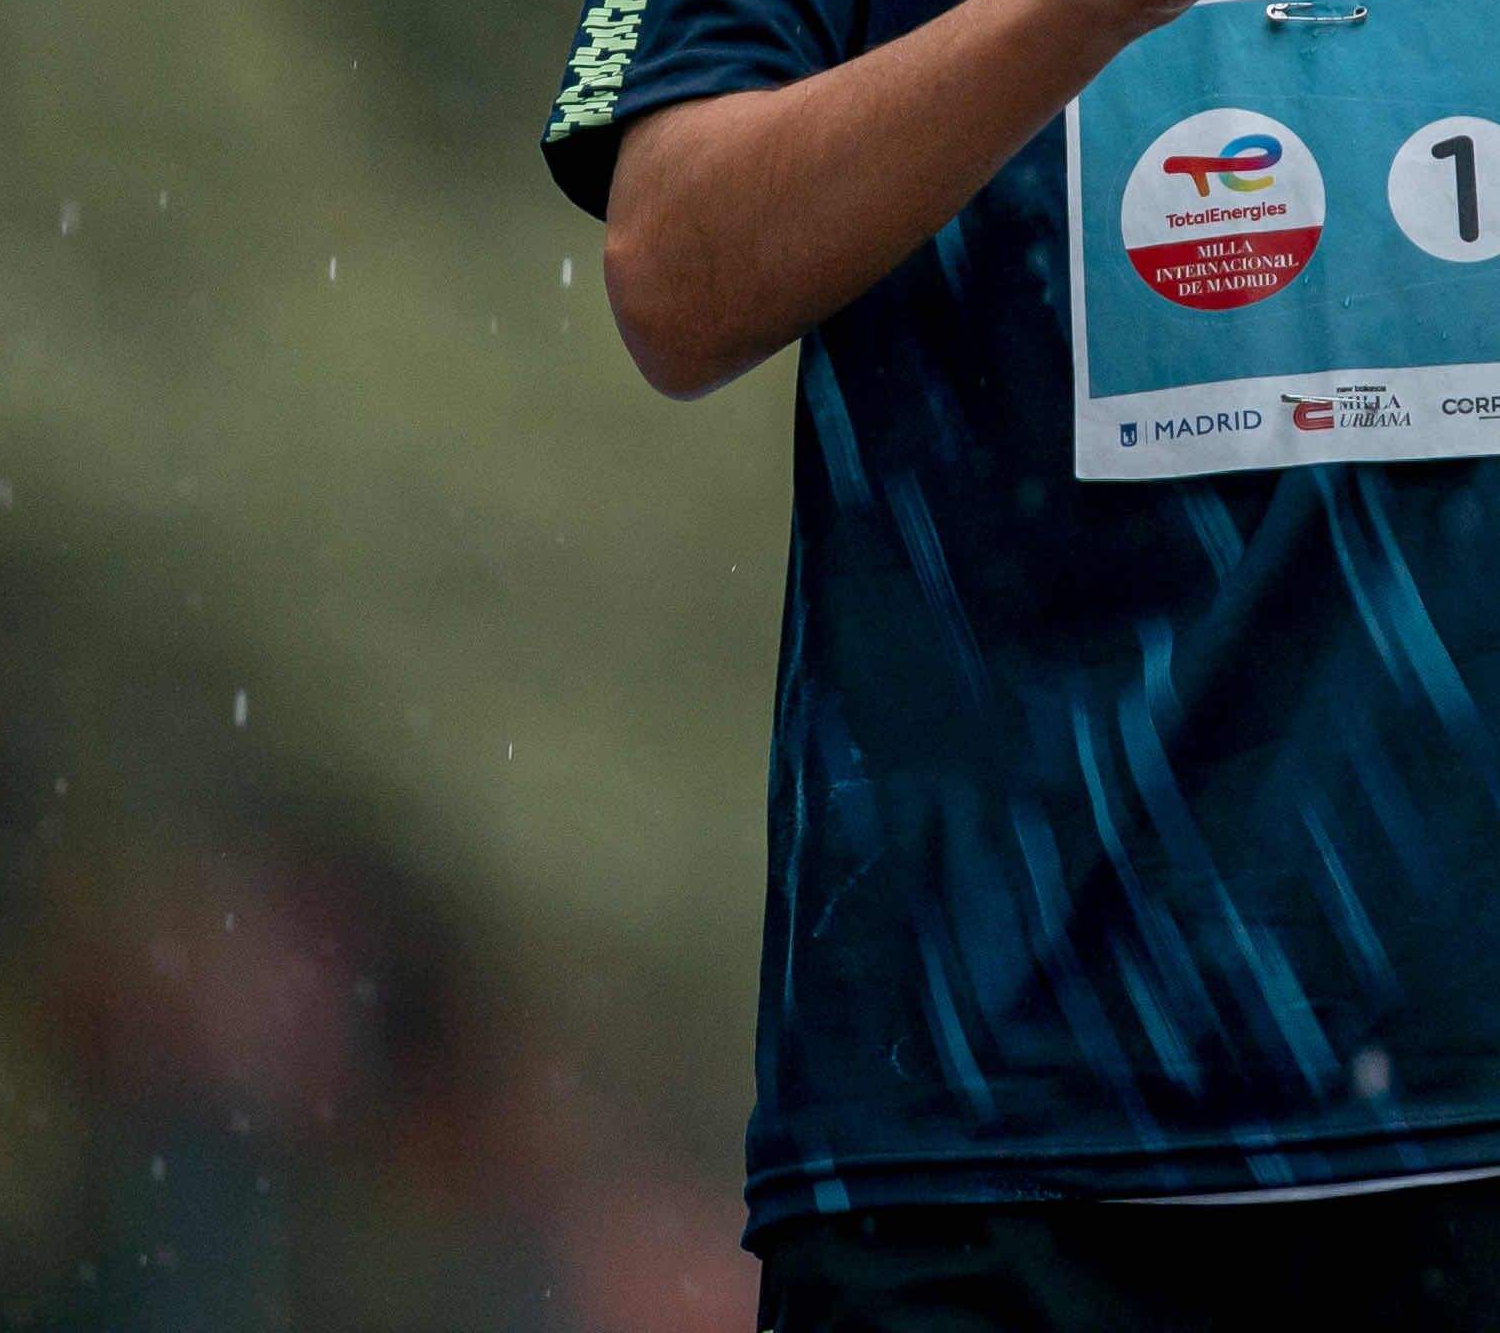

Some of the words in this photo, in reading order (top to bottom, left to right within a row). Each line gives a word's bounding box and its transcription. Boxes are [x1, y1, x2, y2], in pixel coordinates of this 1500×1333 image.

[1431, 134, 1480, 243] 1
[1166, 201, 1288, 229] TotalEnergies
[1197, 240, 1254, 259] MILLA
[1178, 282, 1203, 297] DE
[1206, 273, 1278, 293] MADRID
[1155, 410, 1262, 441] MADRID
[1340, 411, 1412, 428] URBANA
